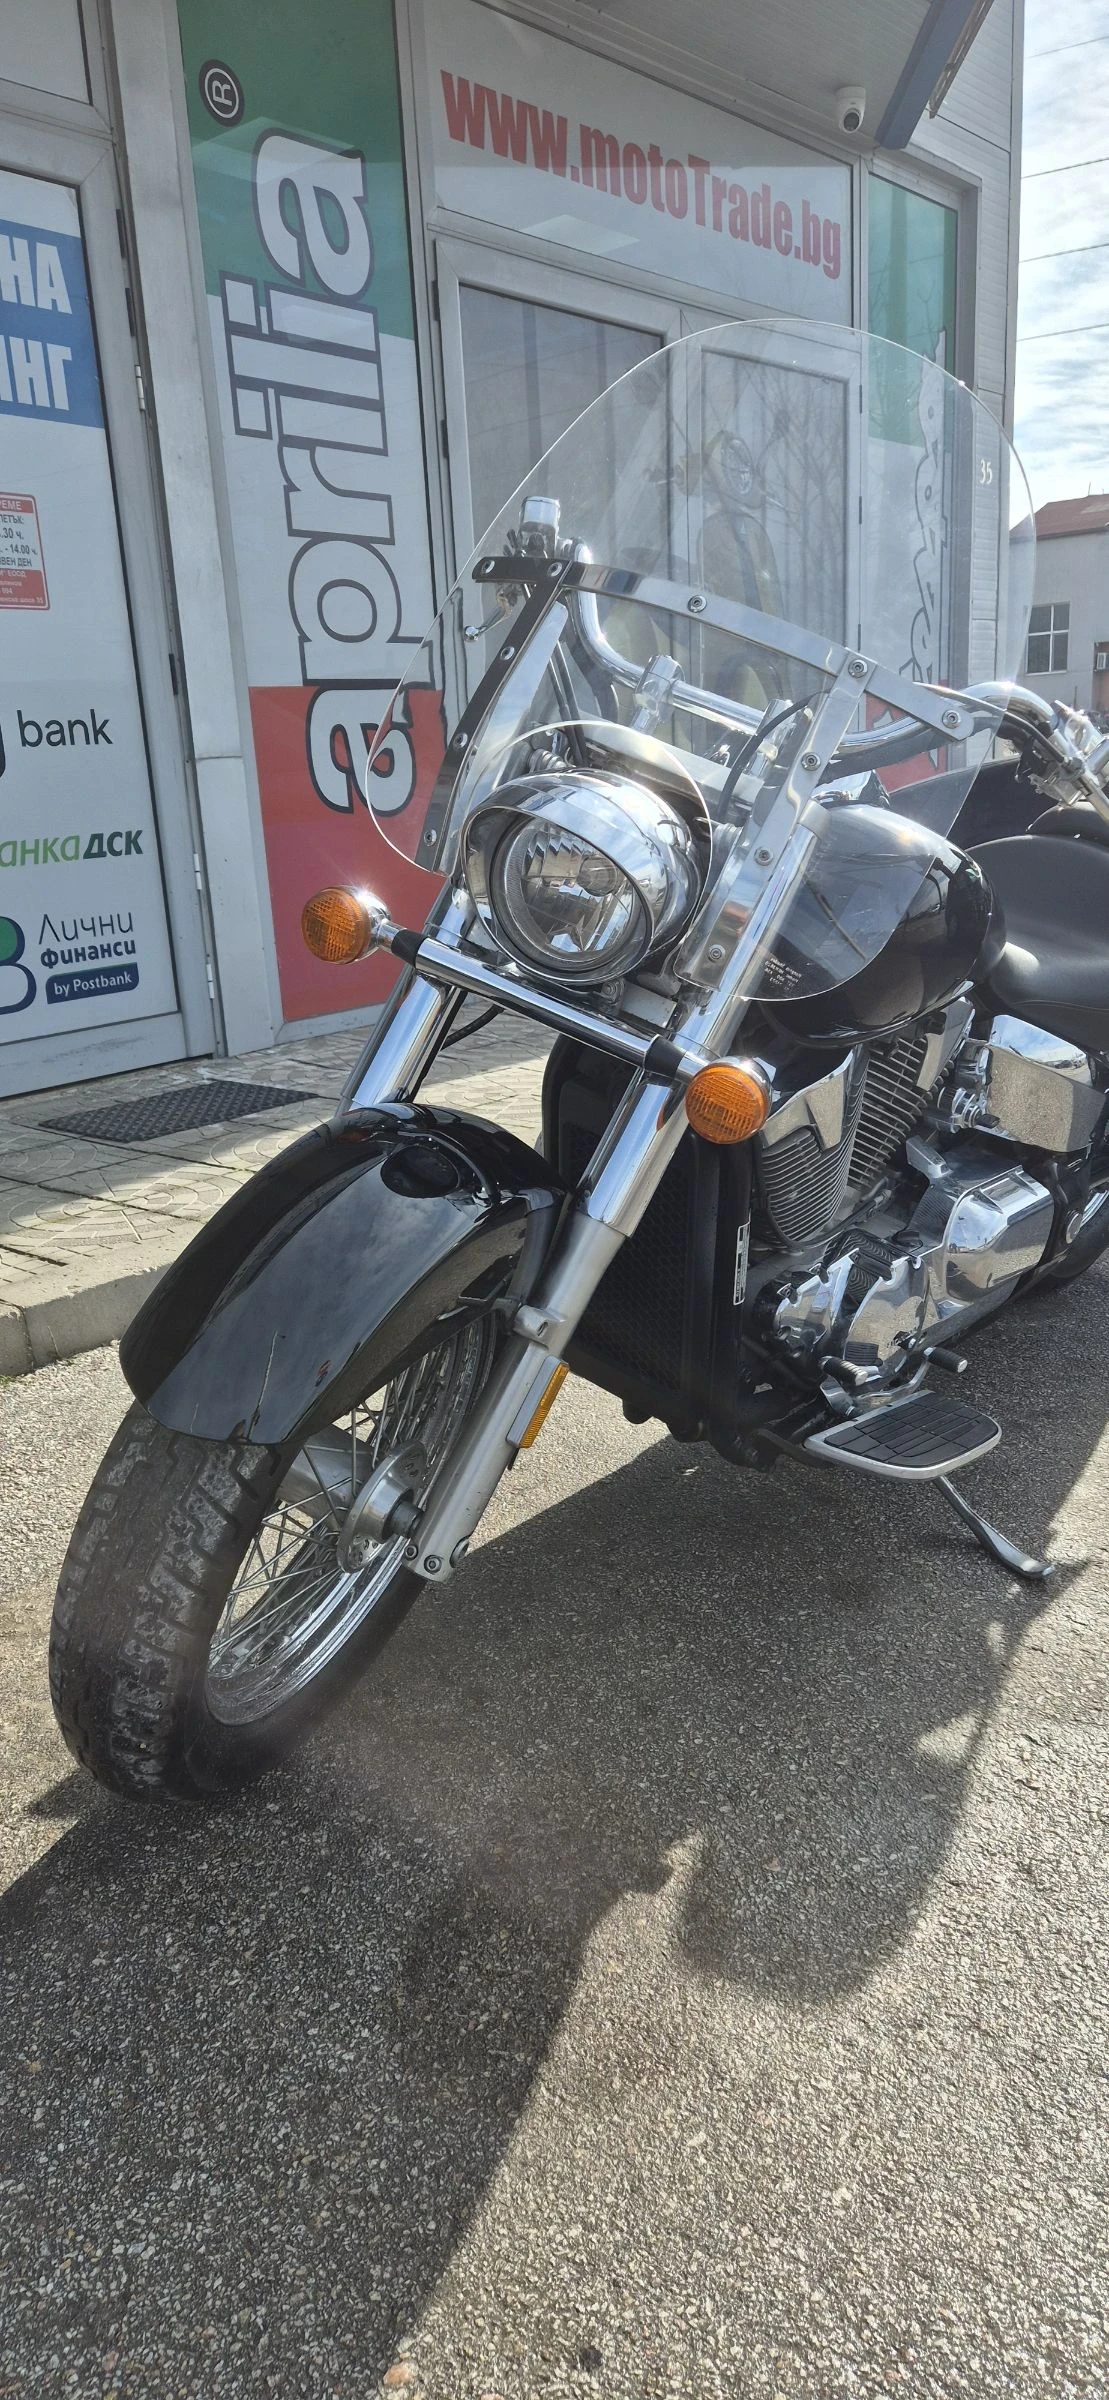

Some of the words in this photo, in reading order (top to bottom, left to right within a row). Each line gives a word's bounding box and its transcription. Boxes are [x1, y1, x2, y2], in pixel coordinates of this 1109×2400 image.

[440, 69, 841, 280] www.motoTrade.bg
[220, 127, 435, 816] aprilia
[979, 459, 993, 485] 35
[0, 500, 22, 510] ЕМЕ
[17, 709, 113, 747] bank
[39, 912, 134, 945] Лични
[54, 982, 70, 997] by
[73, 971, 132, 992] Postbank
